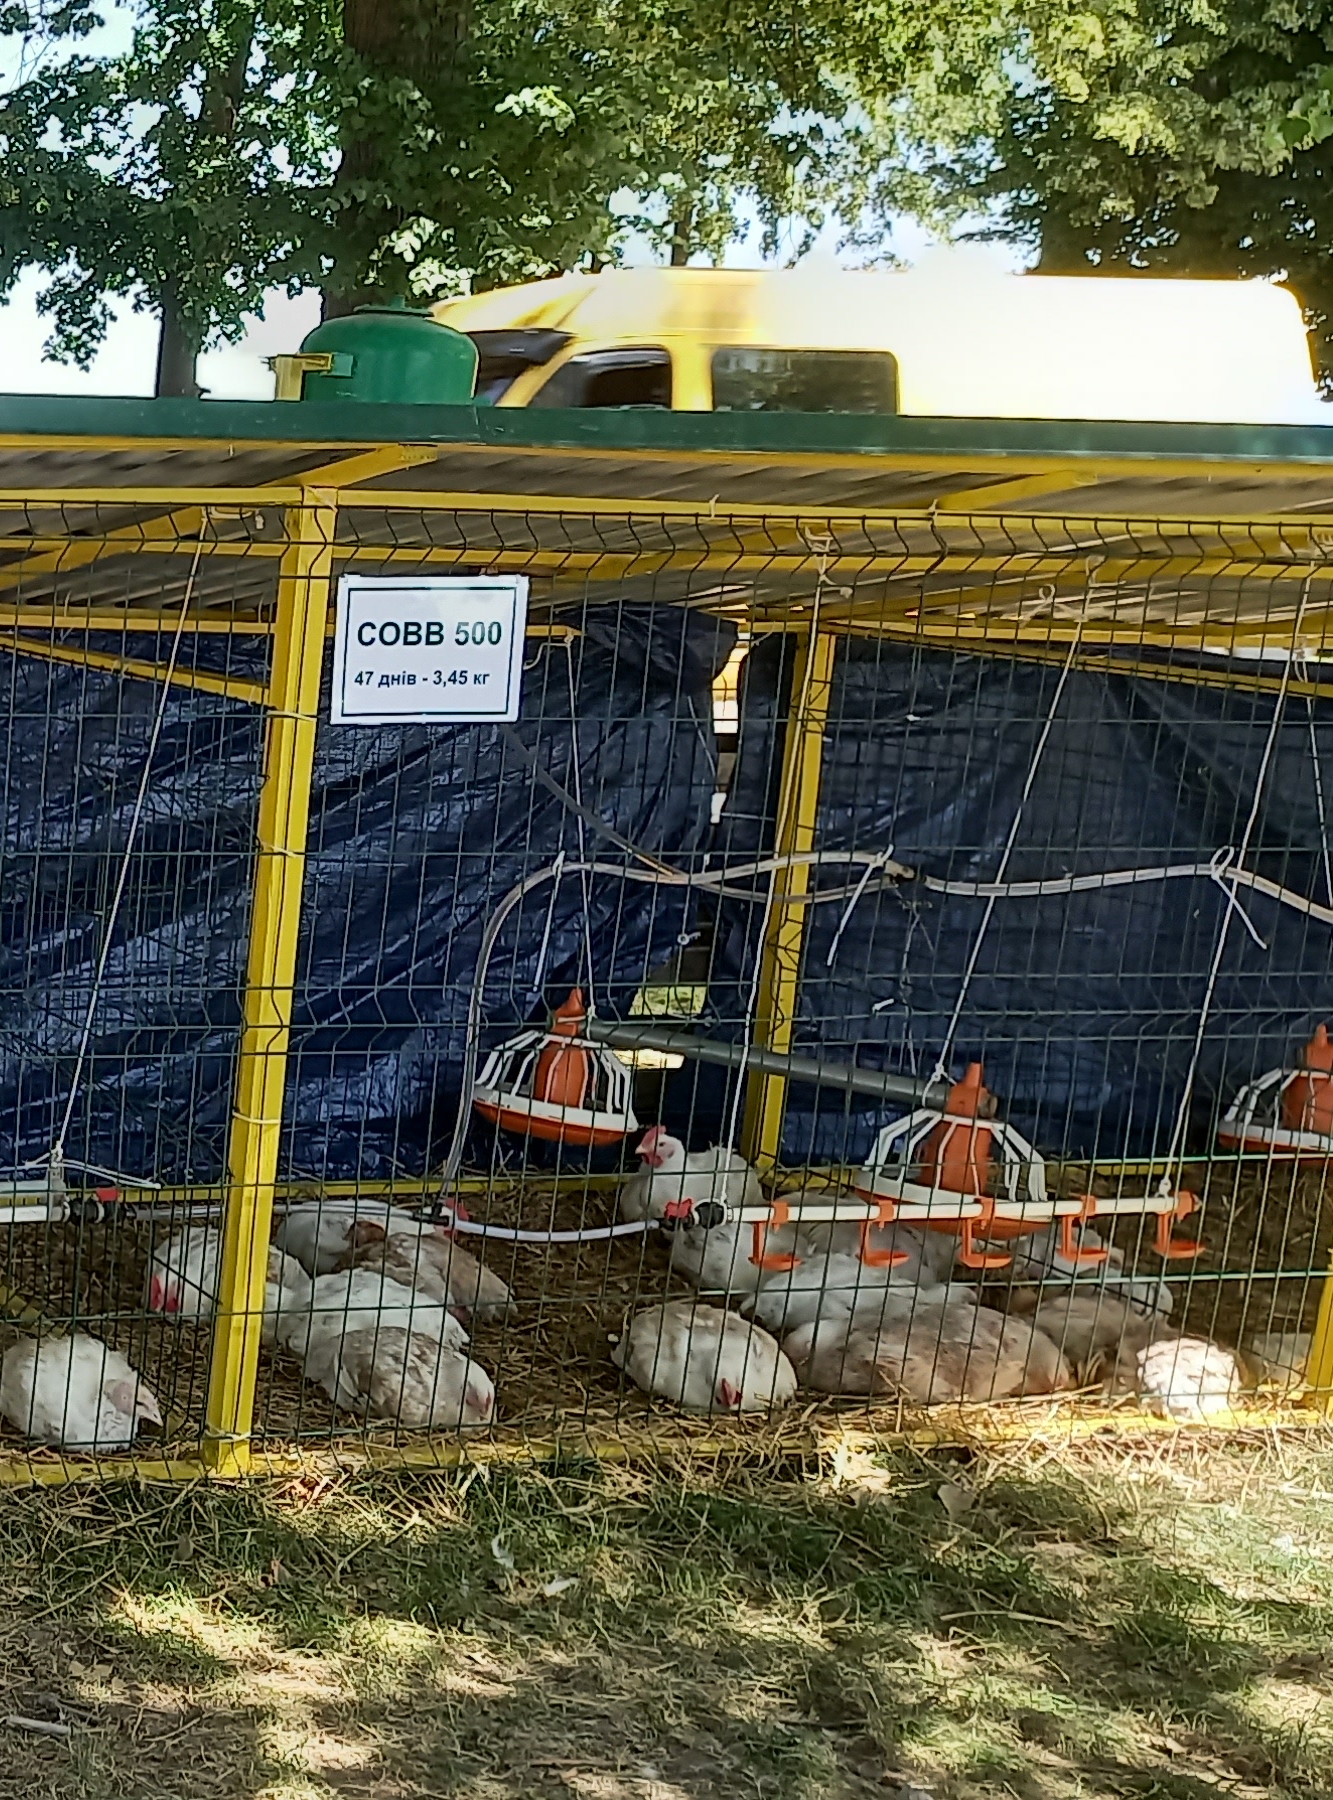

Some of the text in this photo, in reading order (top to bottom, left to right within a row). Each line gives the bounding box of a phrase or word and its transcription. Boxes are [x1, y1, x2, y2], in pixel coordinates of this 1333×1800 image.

[357, 621, 502, 647] COBB 500
[354, 671, 374, 685] 47
[378, 670, 417, 688] днів
[433, 670, 468, 688] 3,45
[473, 672, 490, 685] кг
